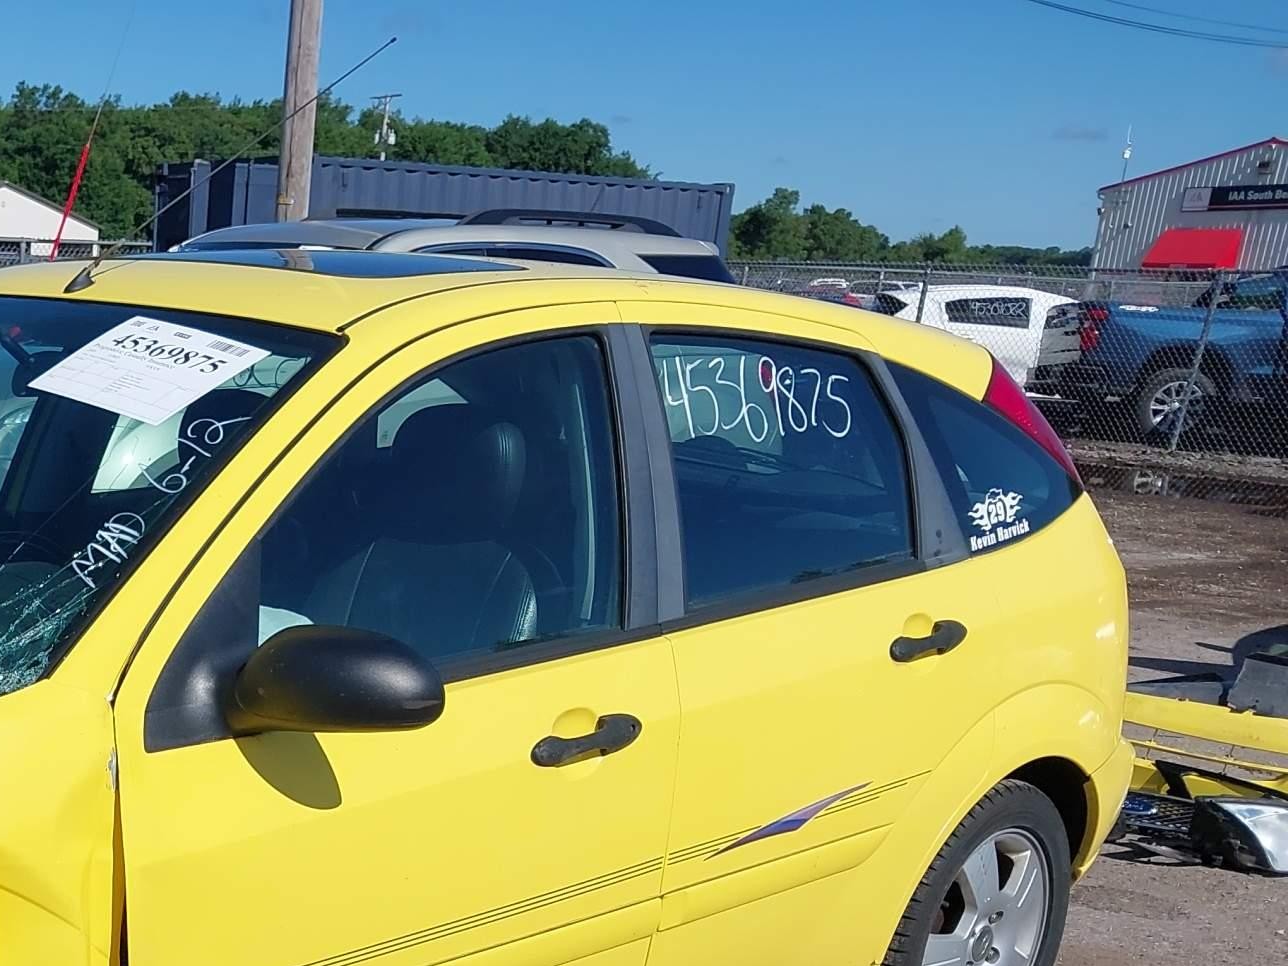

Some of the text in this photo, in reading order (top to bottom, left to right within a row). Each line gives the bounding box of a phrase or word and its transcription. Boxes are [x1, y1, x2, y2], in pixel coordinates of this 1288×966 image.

[1228, 191, 1245, 201] IAA
[1246, 190, 1273, 201] South
[111, 333, 228, 374] 45369875
[662, 355, 852, 443] 45369875
[138, 416, 253, 494] 6-12
[988, 500, 1006, 525] 29
[970, 517, 1031, 552] Kevin Harvick
